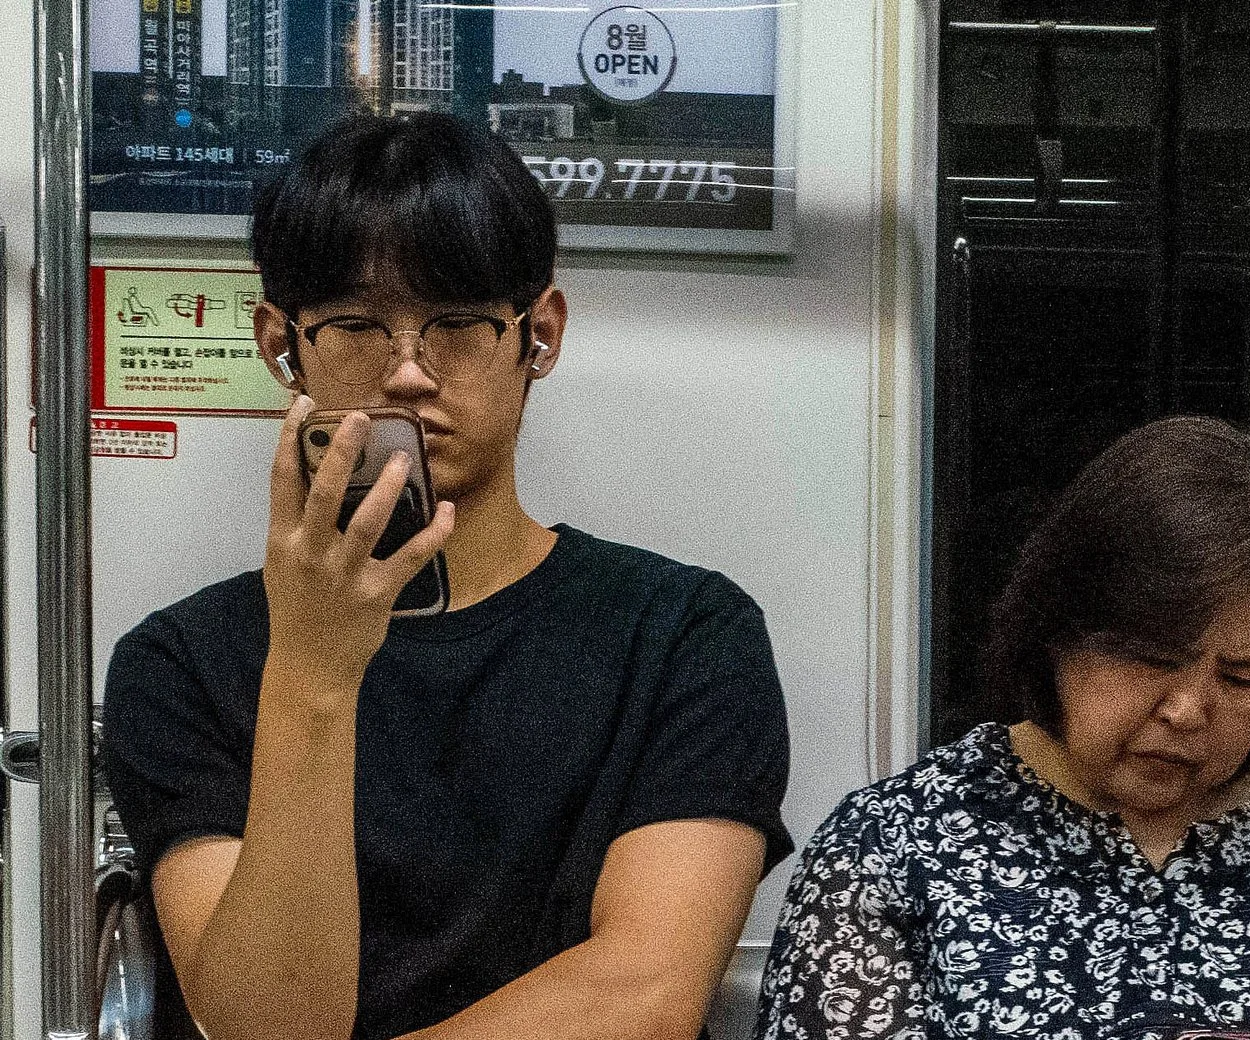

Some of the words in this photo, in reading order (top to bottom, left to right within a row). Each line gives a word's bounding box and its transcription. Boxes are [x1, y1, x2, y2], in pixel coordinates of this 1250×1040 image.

[607, 23, 648, 52] 8월
[594, 53, 659, 76] OPEN
[125, 145, 172, 162] 아파트
[175, 146, 234, 164] 145세대
